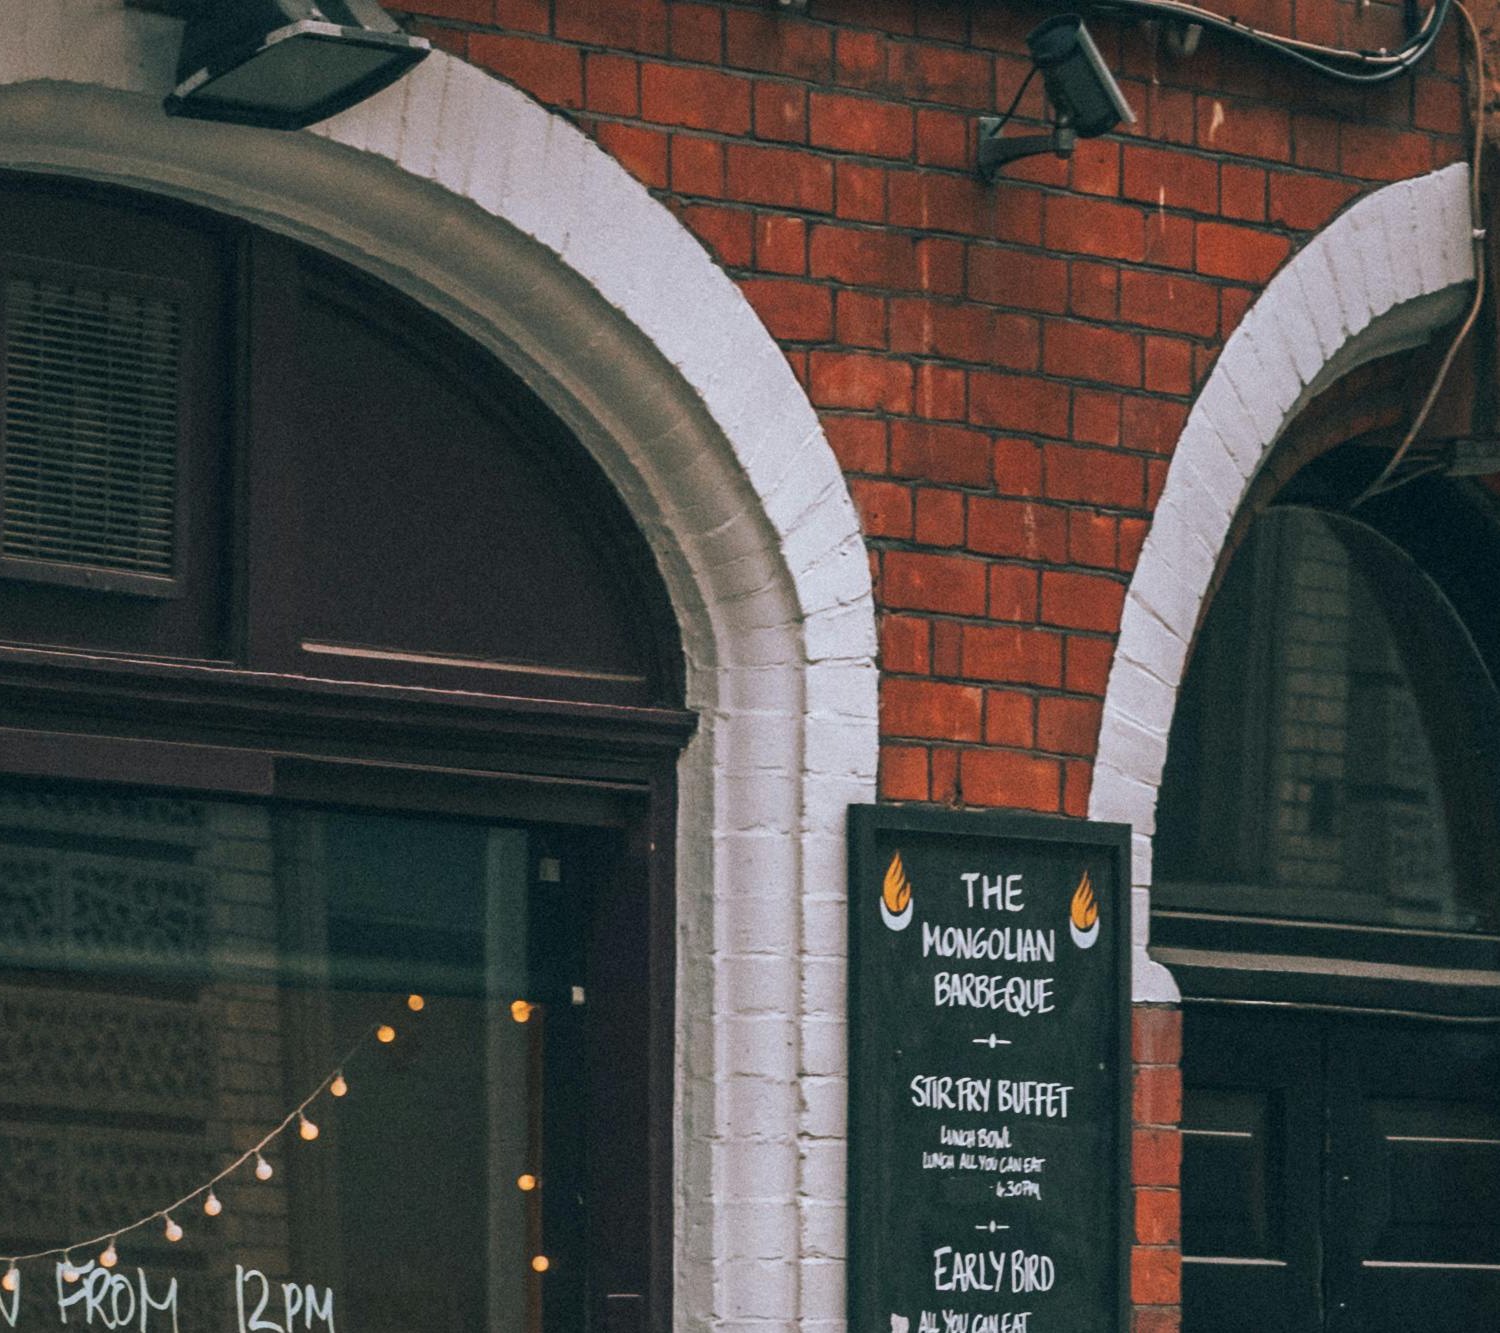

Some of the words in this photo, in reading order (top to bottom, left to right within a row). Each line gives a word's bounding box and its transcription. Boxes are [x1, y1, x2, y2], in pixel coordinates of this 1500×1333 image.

[961, 872, 1026, 912] THE
[922, 921, 1055, 963] MONGOLIAN
[933, 971, 1055, 1017] BARBEQUE
[997, 1079, 1075, 1119] BUFFET
[940, 1125, 976, 1149] LUNCH
[977, 1126, 1013, 1149] BOWL
[922, 1152, 955, 1170] LUNCH
[959, 1153, 979, 1171] ALL
[978, 1154, 998, 1172] YOU
[999, 1156, 1022, 1174] CAN
[1023, 1156, 1047, 1174] EAT
[933, 1246, 1006, 1293] EARLY
[1010, 1250, 1055, 1293] BIRD
